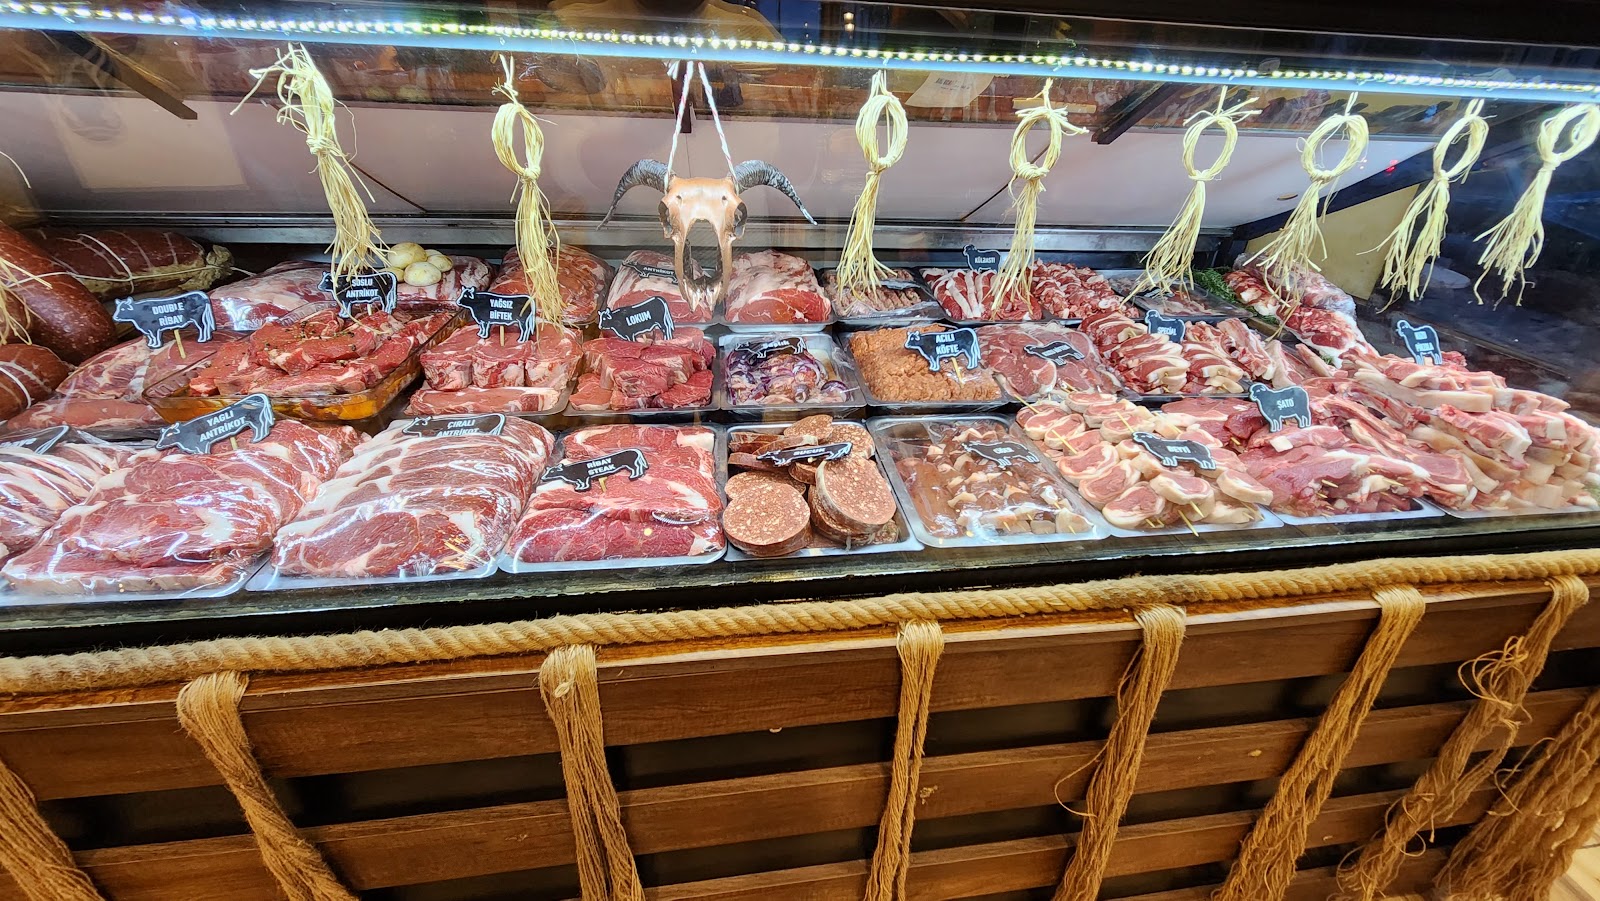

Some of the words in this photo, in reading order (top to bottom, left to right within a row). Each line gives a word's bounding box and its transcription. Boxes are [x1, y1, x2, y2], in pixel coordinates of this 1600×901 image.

[351, 278, 373, 287] SOSLU
[346, 288, 378, 298] ANTRİKOT
[152, 302, 184, 315] DOUBLE
[490, 298, 513, 309] YAĞSIZ
[158, 315, 183, 326] RİBAY
[490, 310, 513, 321] BİFTEK
[625, 310, 652, 326] LOKUM
[936, 334, 955, 343] ACILI
[936, 344, 959, 355] KÖFTE
[200, 416, 246, 442] ANTRİKOT
[587, 458, 612, 469] RİBAY
[588, 464, 615, 476] STEAK
